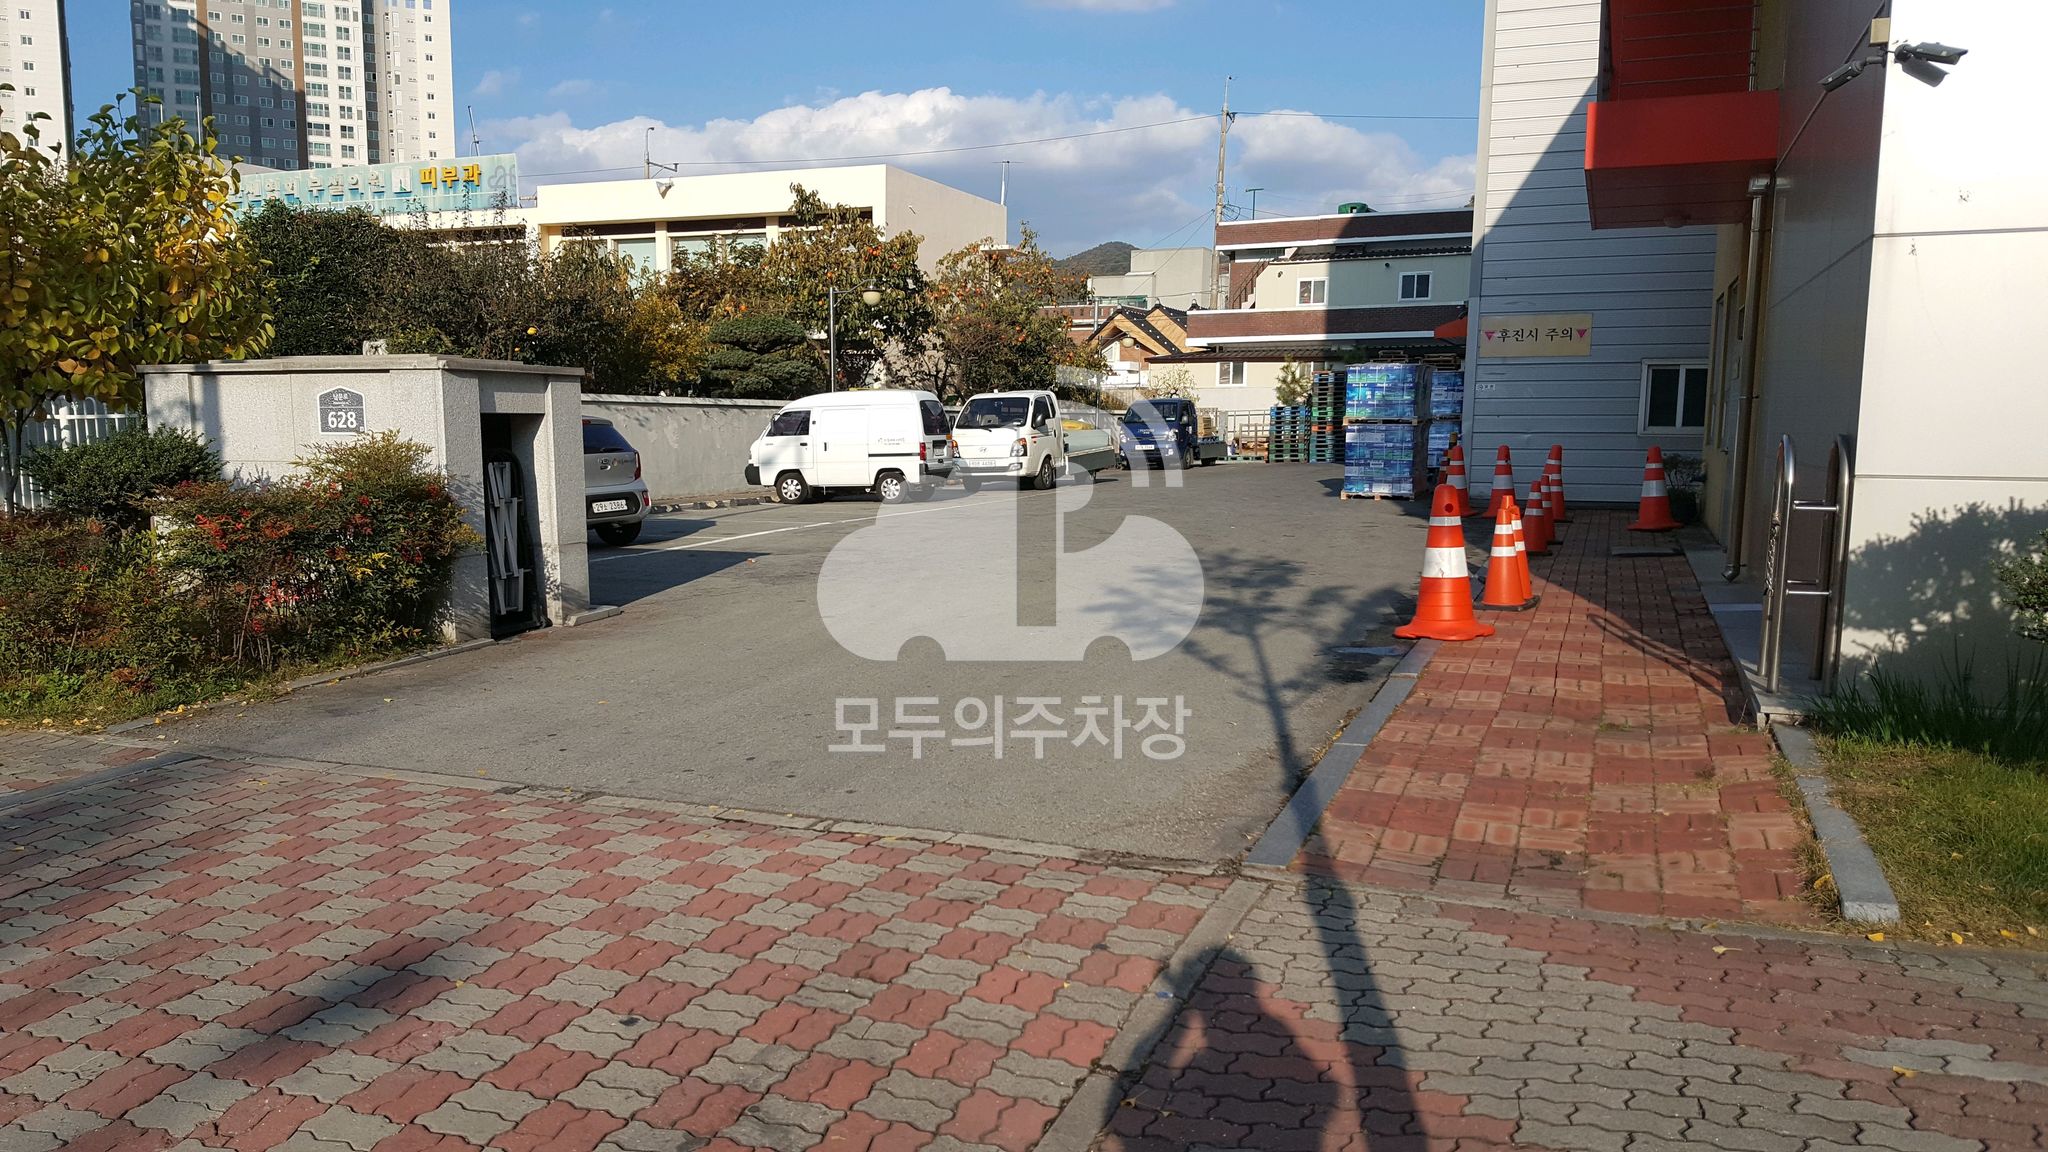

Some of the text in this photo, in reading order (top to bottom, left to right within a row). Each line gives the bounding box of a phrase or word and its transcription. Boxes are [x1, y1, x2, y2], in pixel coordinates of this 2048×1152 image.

[420, 164, 481, 189] 피부과
[1497, 327, 1573, 343] 후진시 주의
[328, 411, 357, 429] 628
